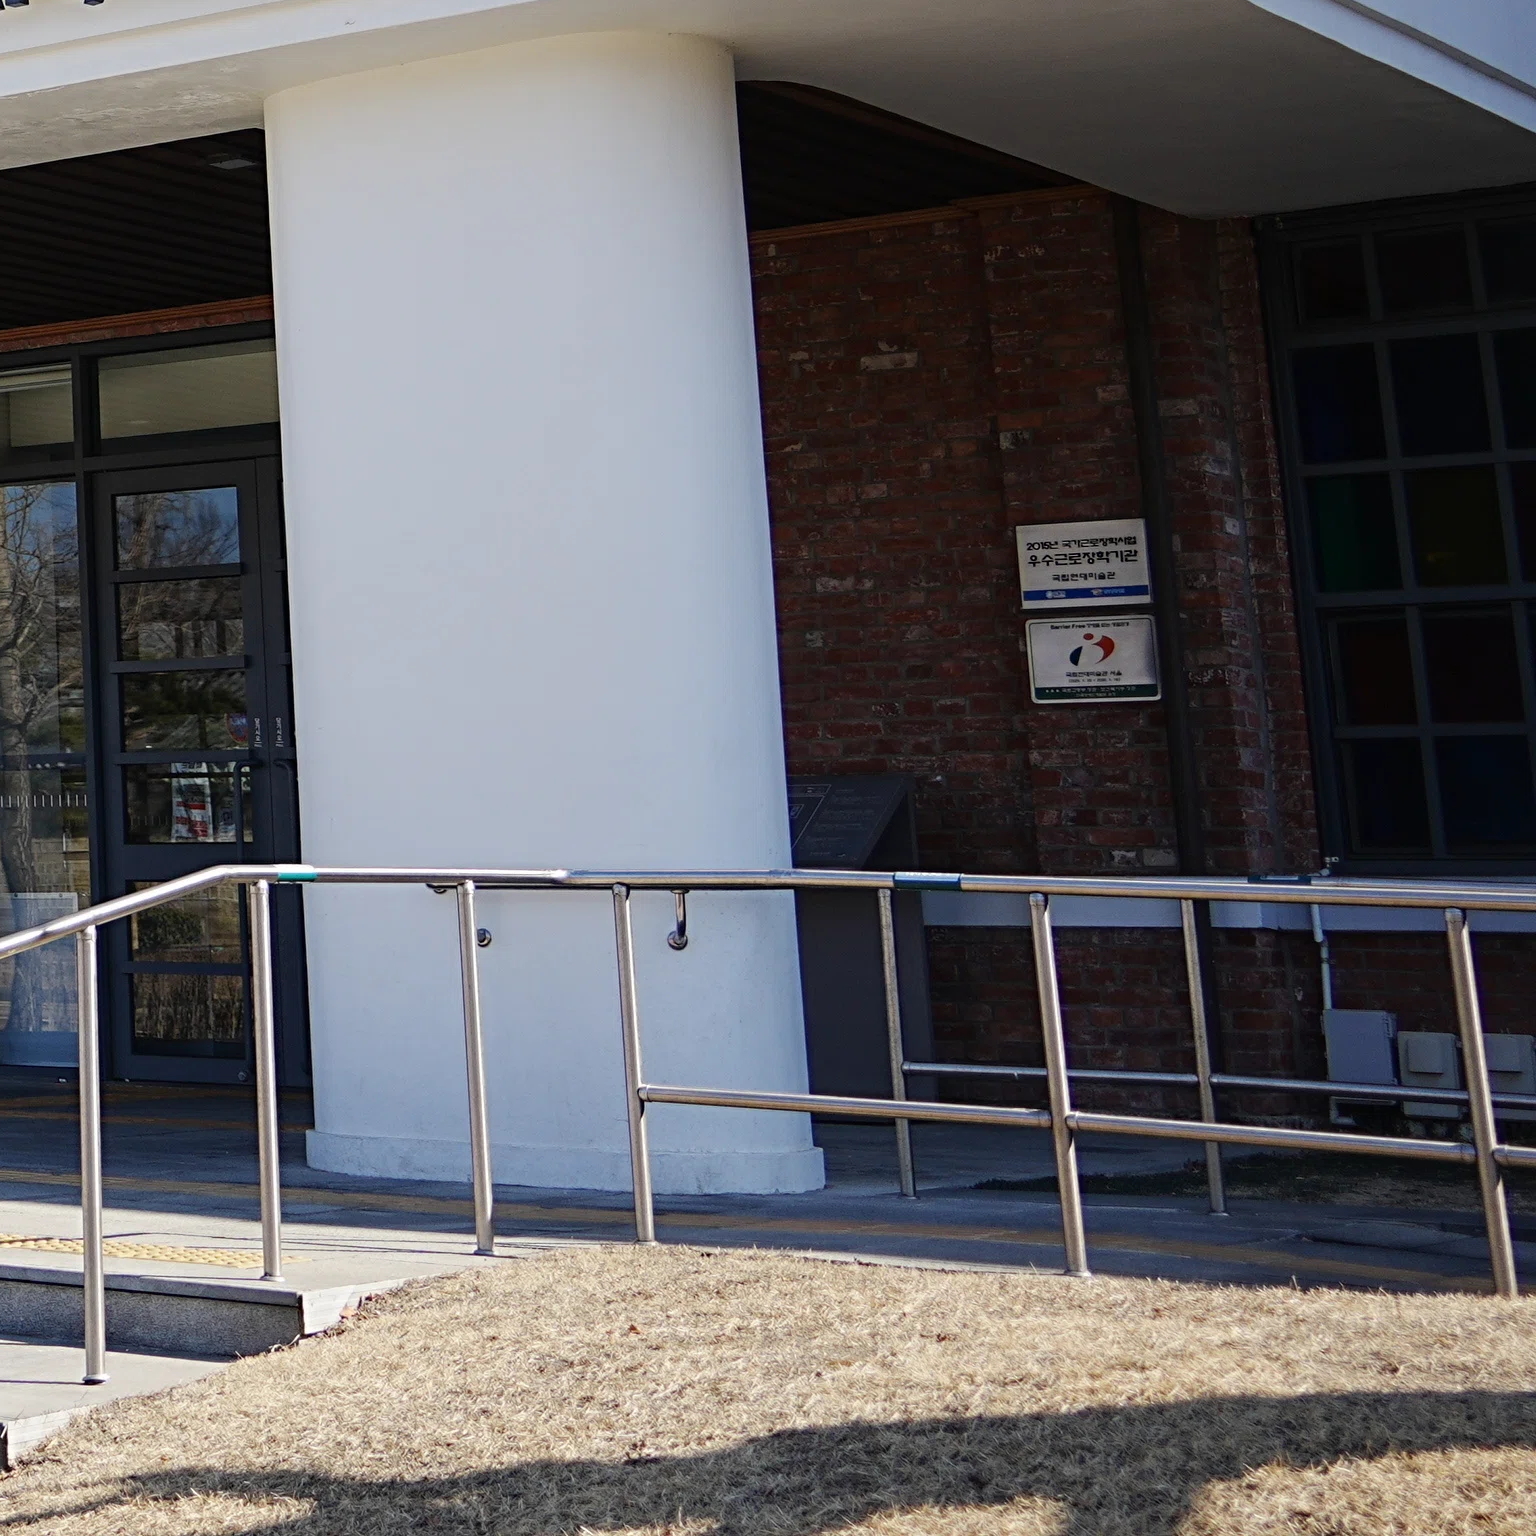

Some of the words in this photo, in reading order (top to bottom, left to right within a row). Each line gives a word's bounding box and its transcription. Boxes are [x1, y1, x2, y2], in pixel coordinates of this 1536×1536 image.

[1026, 541, 1059, 551] 2015년
[1028, 550, 1139, 567] 우수근로장학기관
[1052, 572, 1116, 582] 국립현대미술관
